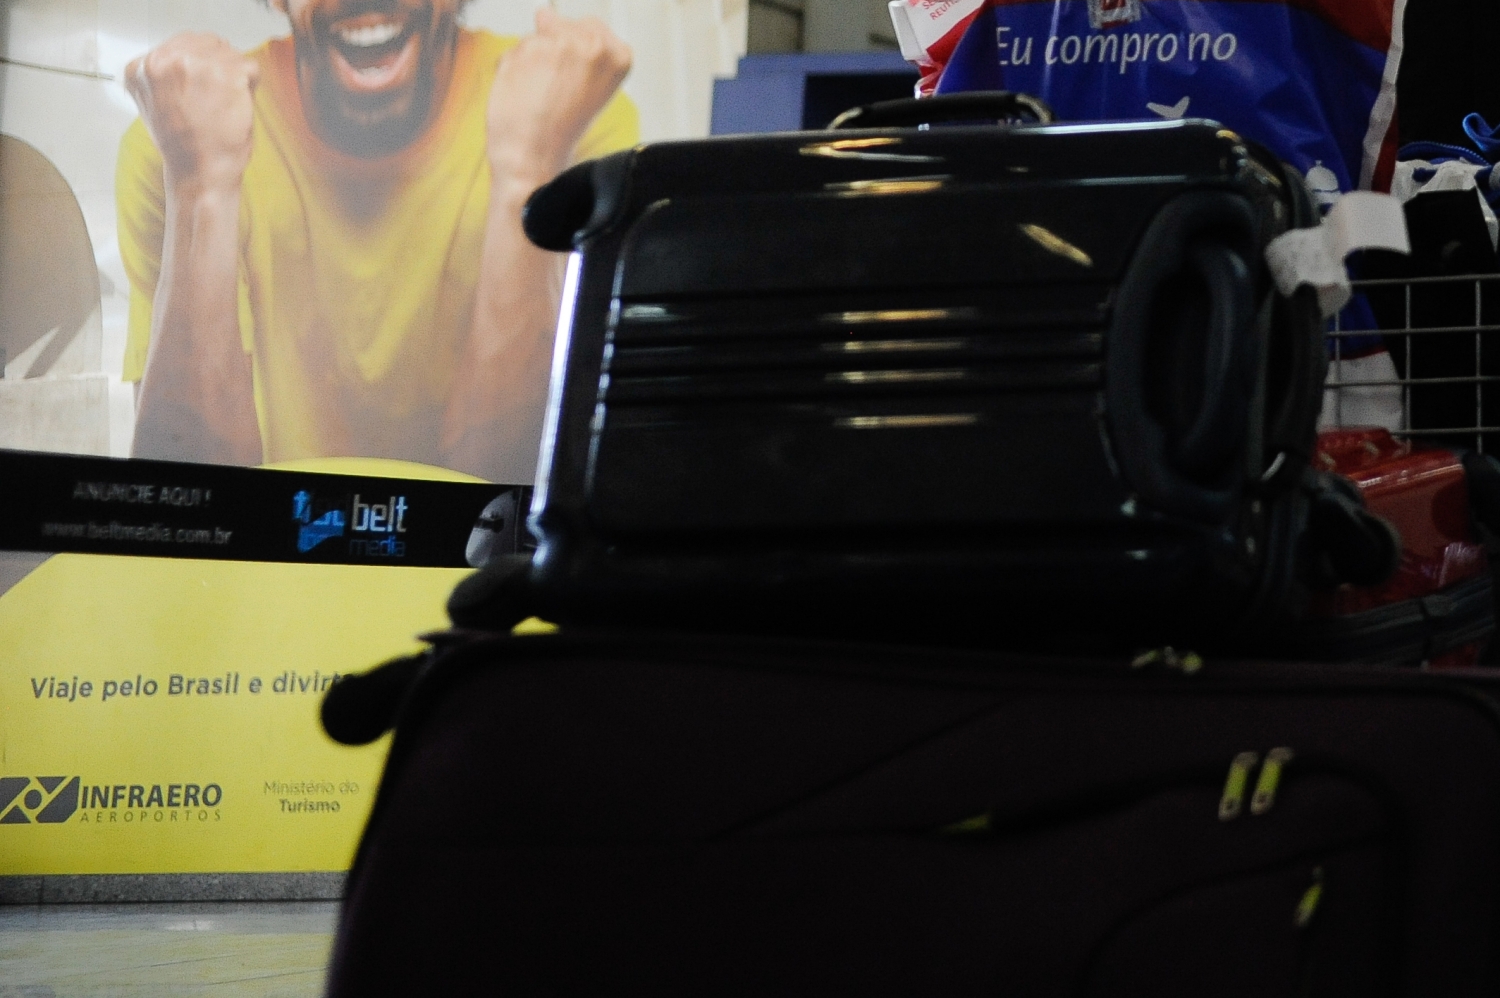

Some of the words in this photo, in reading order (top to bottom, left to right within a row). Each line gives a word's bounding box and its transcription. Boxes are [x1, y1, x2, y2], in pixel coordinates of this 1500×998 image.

[996, 25, 1033, 66] Eu
[1045, 30, 1179, 75] compro
[1187, 31, 1238, 62] no
[352, 493, 409, 533] belt
[349, 534, 407, 558] media
[30, 676, 93, 702] Viaje
[102, 675, 158, 701] pelo
[168, 672, 240, 697] Brasil
[249, 676, 262, 694] e
[81, 782, 222, 810] INFRAERO
[339, 781, 359, 794] do
[80, 809, 222, 824] AEROPORTOS
[279, 798, 341, 814] Turismo
